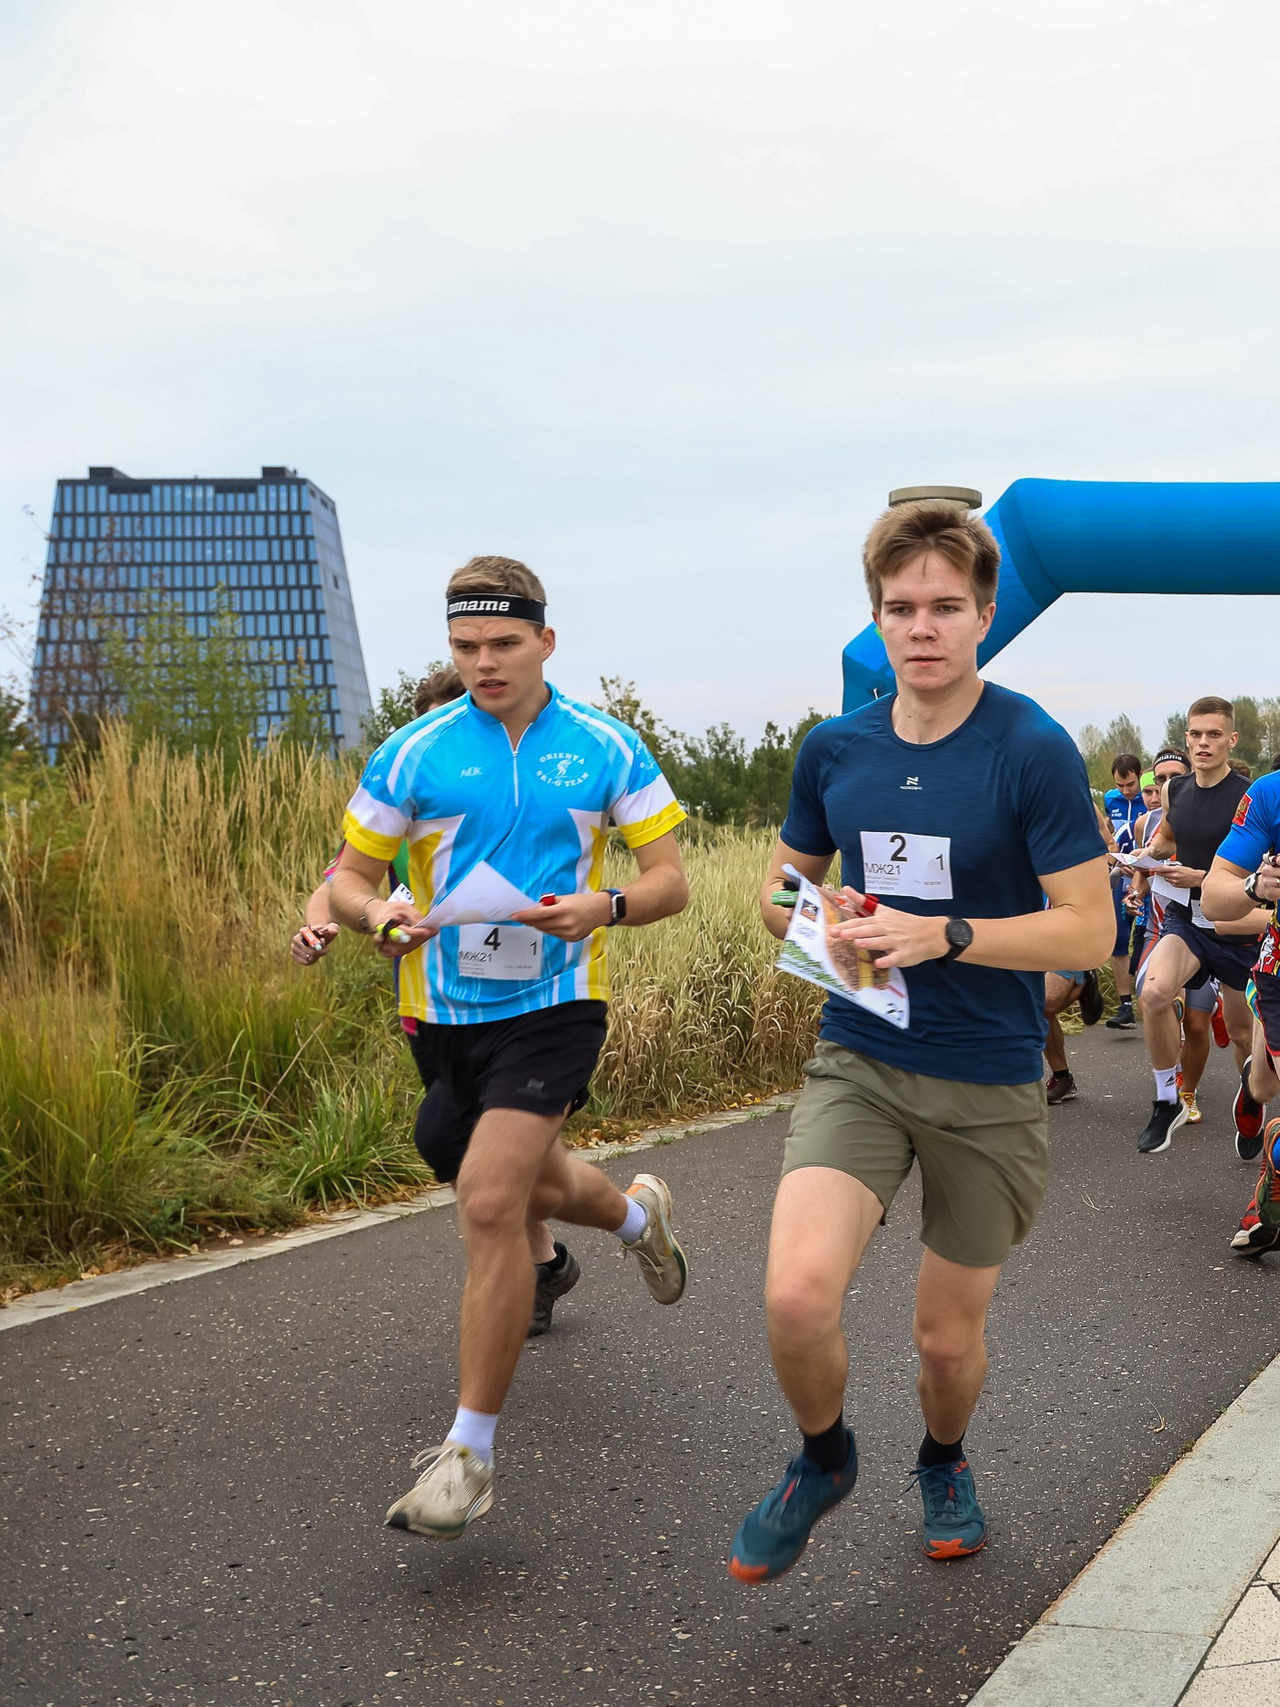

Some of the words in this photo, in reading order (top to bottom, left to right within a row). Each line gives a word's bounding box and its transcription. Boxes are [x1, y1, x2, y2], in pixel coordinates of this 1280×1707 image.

[539, 752, 585, 765] ORIENTA
[563, 771, 590, 787] TEAM
[889, 834, 908, 862] 2
[865, 862, 901, 876] МЖ21
[935, 853, 944, 871] 1
[483, 926, 502, 951] 4
[530, 941, 538, 956] 1
[459, 951, 493, 964] МЖ21
